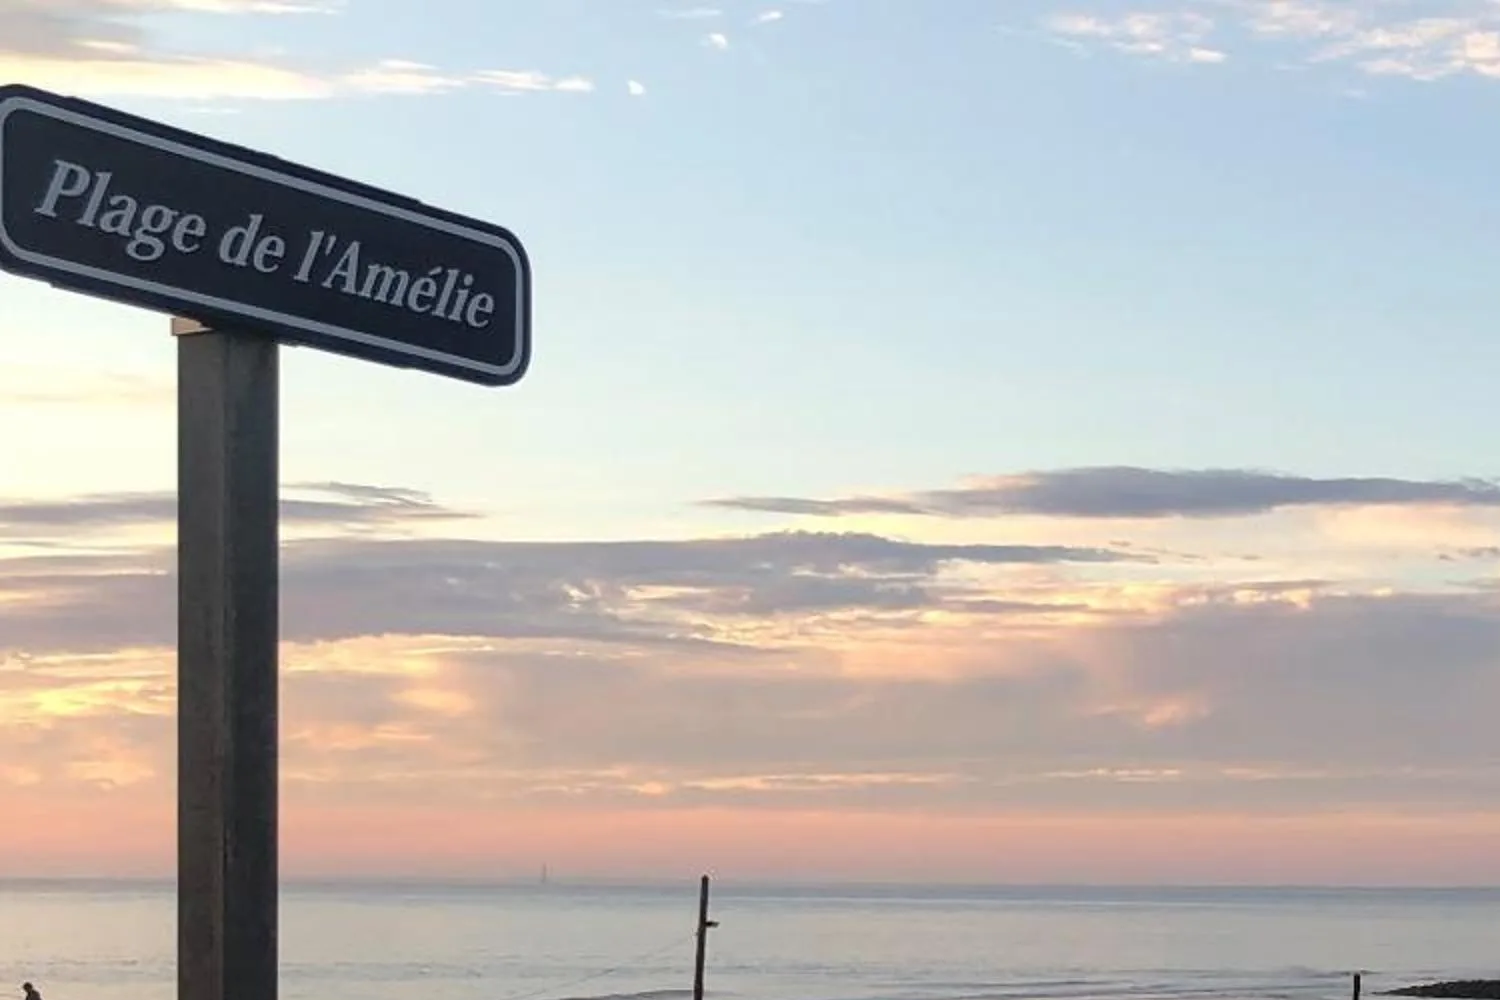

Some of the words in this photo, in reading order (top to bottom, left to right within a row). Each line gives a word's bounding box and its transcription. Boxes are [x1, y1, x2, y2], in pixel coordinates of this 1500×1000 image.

[33, 159, 206, 262] Plage
[218, 213, 286, 273] de
[293, 230, 496, 329] l'Amélie
